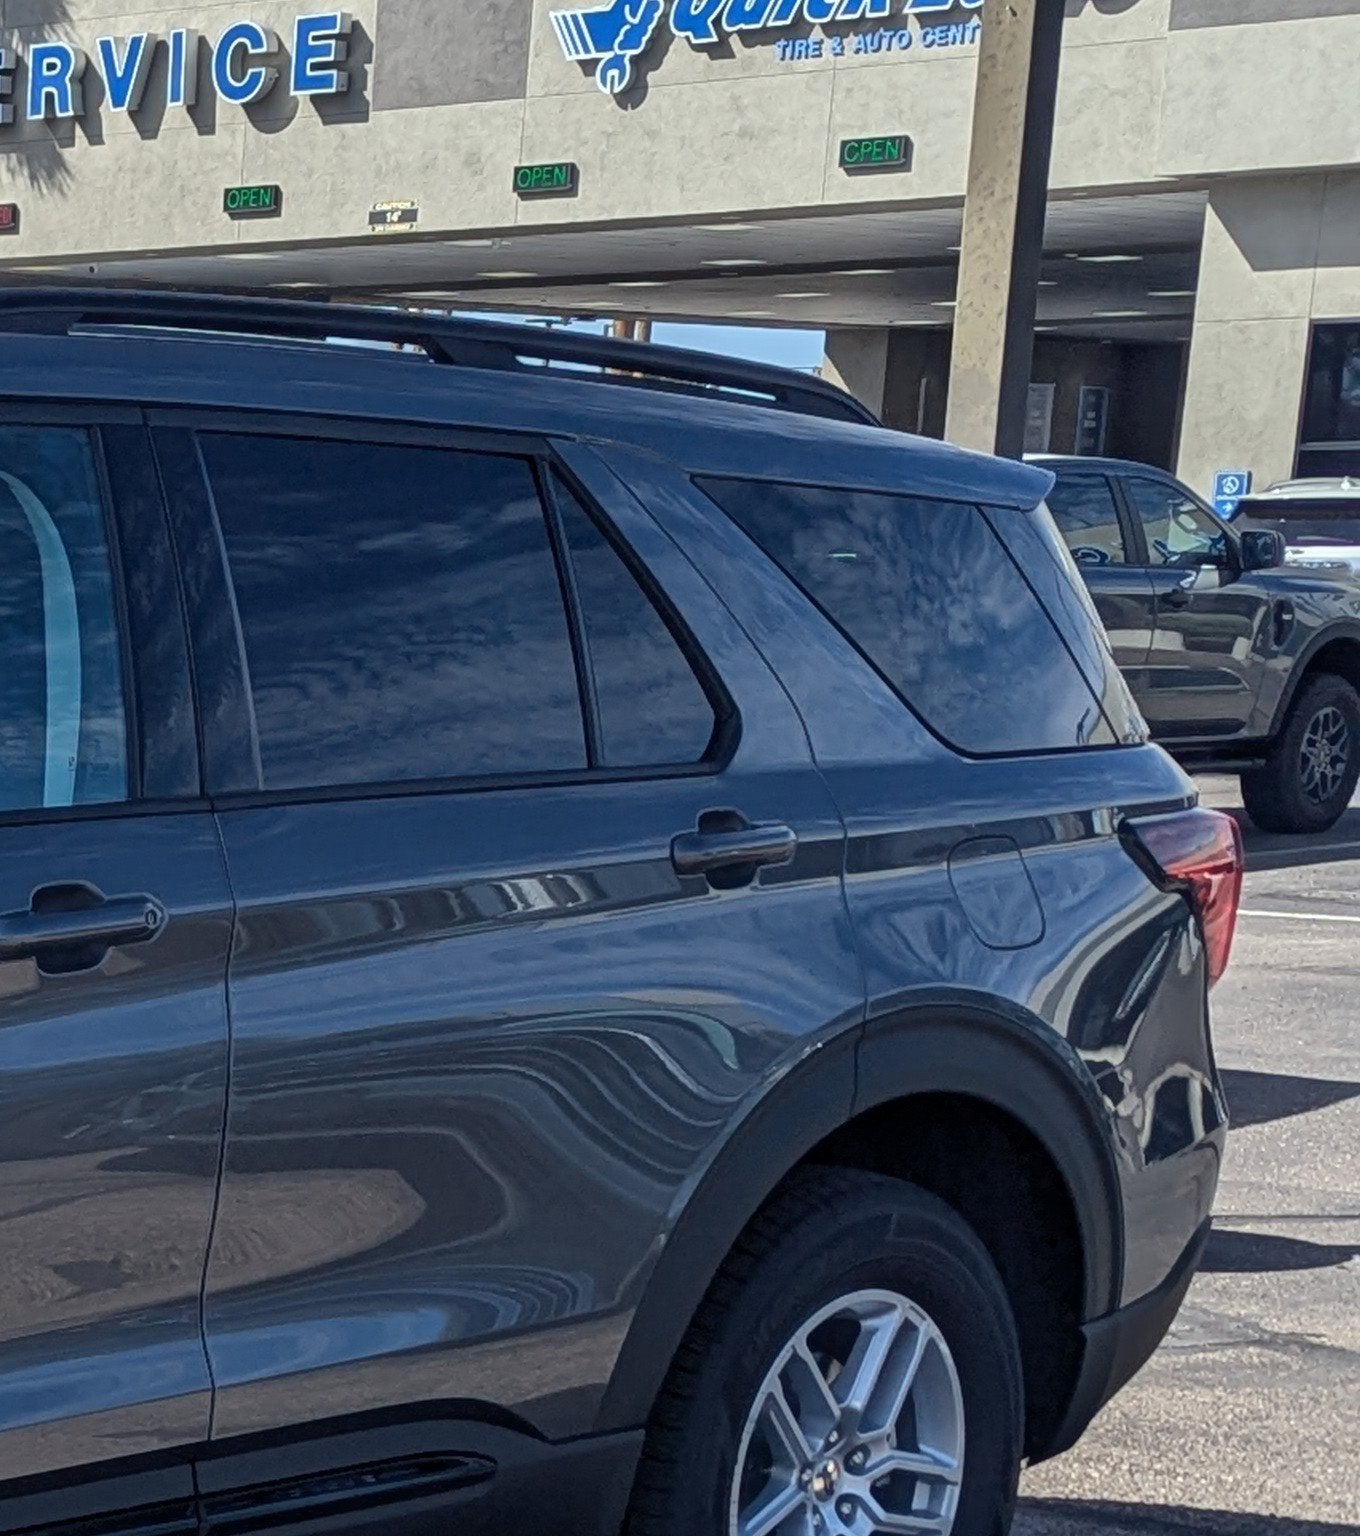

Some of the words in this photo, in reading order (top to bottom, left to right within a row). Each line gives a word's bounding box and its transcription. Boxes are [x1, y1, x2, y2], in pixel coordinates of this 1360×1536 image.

[774, 38, 823, 62] TIRE
[830, 35, 845, 57] &
[853, 27, 912, 54] AUTO
[921, 20, 981, 48] CENT
[516, 166, 567, 188] OPEN
[227, 188, 272, 209] OPEN
